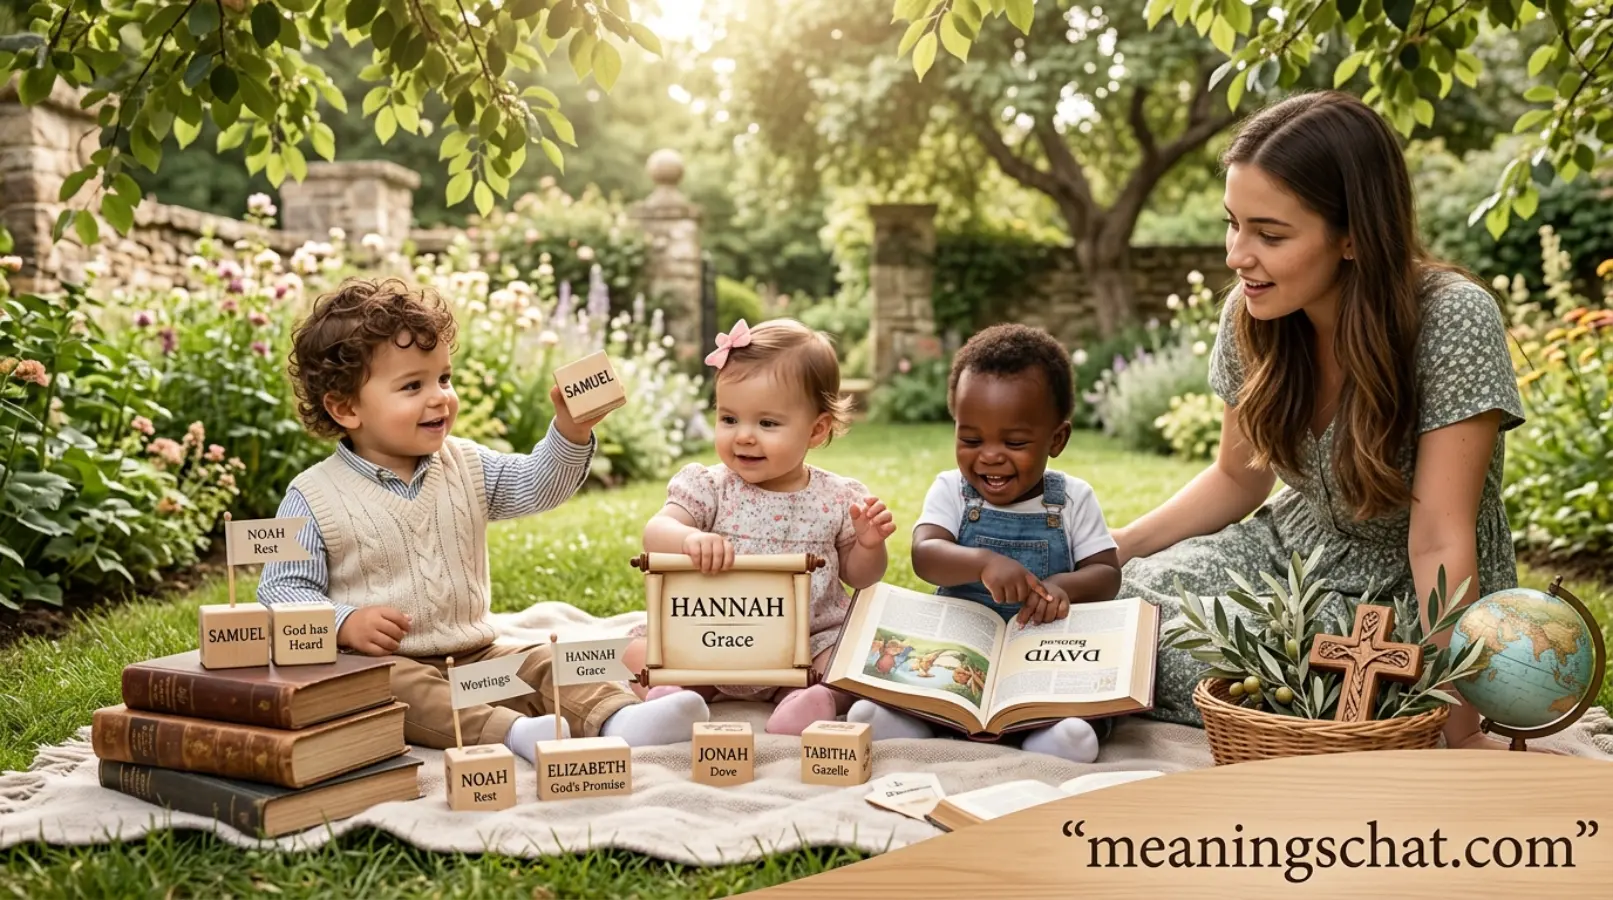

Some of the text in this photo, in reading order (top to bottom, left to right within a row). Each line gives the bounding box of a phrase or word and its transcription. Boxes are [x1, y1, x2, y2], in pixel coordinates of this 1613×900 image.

[564, 369, 614, 398] SAMUEL
[247, 528, 285, 540] NOAH
[253, 543, 278, 554] Rest
[670, 597, 785, 617] HANNAH
[208, 627, 266, 643] SAMUEL
[282, 623, 329, 636] God has
[289, 637, 324, 650] Heard
[701, 630, 754, 648] Grace
[565, 649, 616, 663] HANNAH
[576, 666, 606, 677] Grace
[698, 747, 748, 762] JONAH
[803, 745, 857, 762] TABITHA
[547, 760, 627, 778] ELIZABETH
[710, 766, 738, 777] Dove
[811, 763, 850, 777] Gazelle
[461, 769, 508, 788] NOAH
[550, 778, 626, 794] God's Promise
[473, 791, 497, 802] Rest
